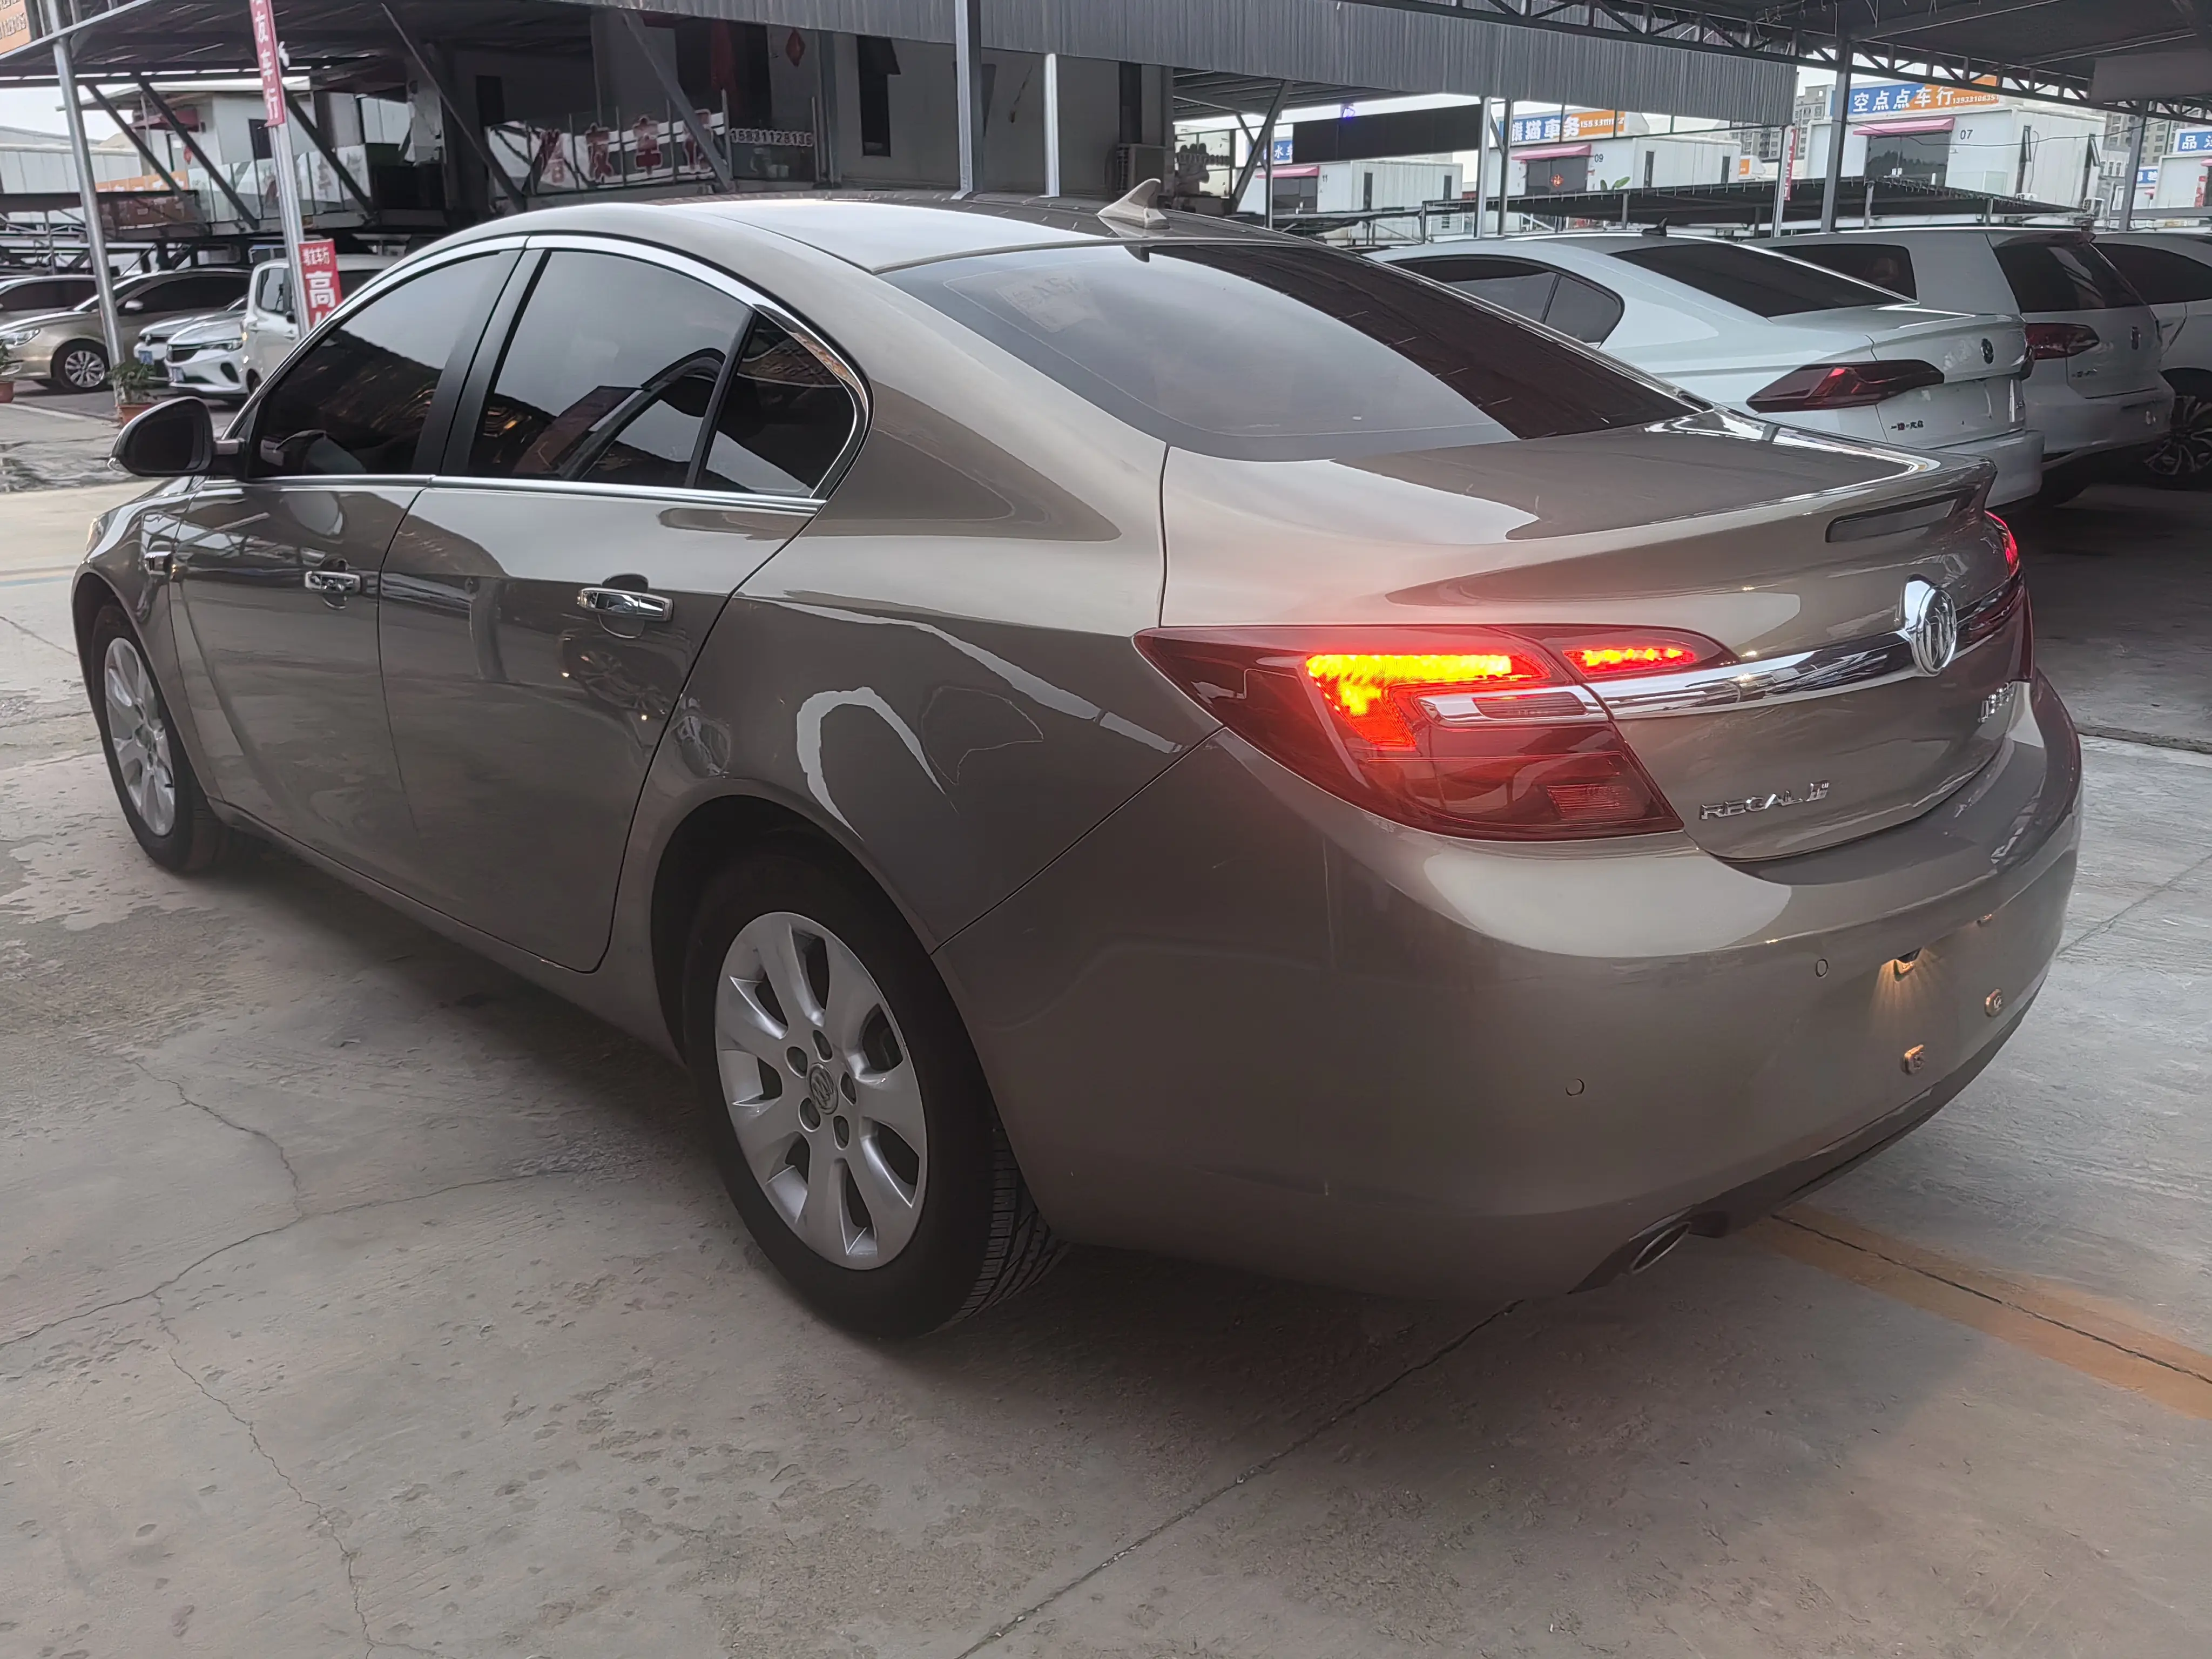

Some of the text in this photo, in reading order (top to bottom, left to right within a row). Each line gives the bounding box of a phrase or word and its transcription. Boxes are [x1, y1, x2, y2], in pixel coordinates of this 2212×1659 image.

[1853, 86, 1954, 112] 空点点车行
[1960, 130, 1973, 140] 07
[1594, 154, 1603, 163] 09
[1700, 790, 1803, 820] REGAL
